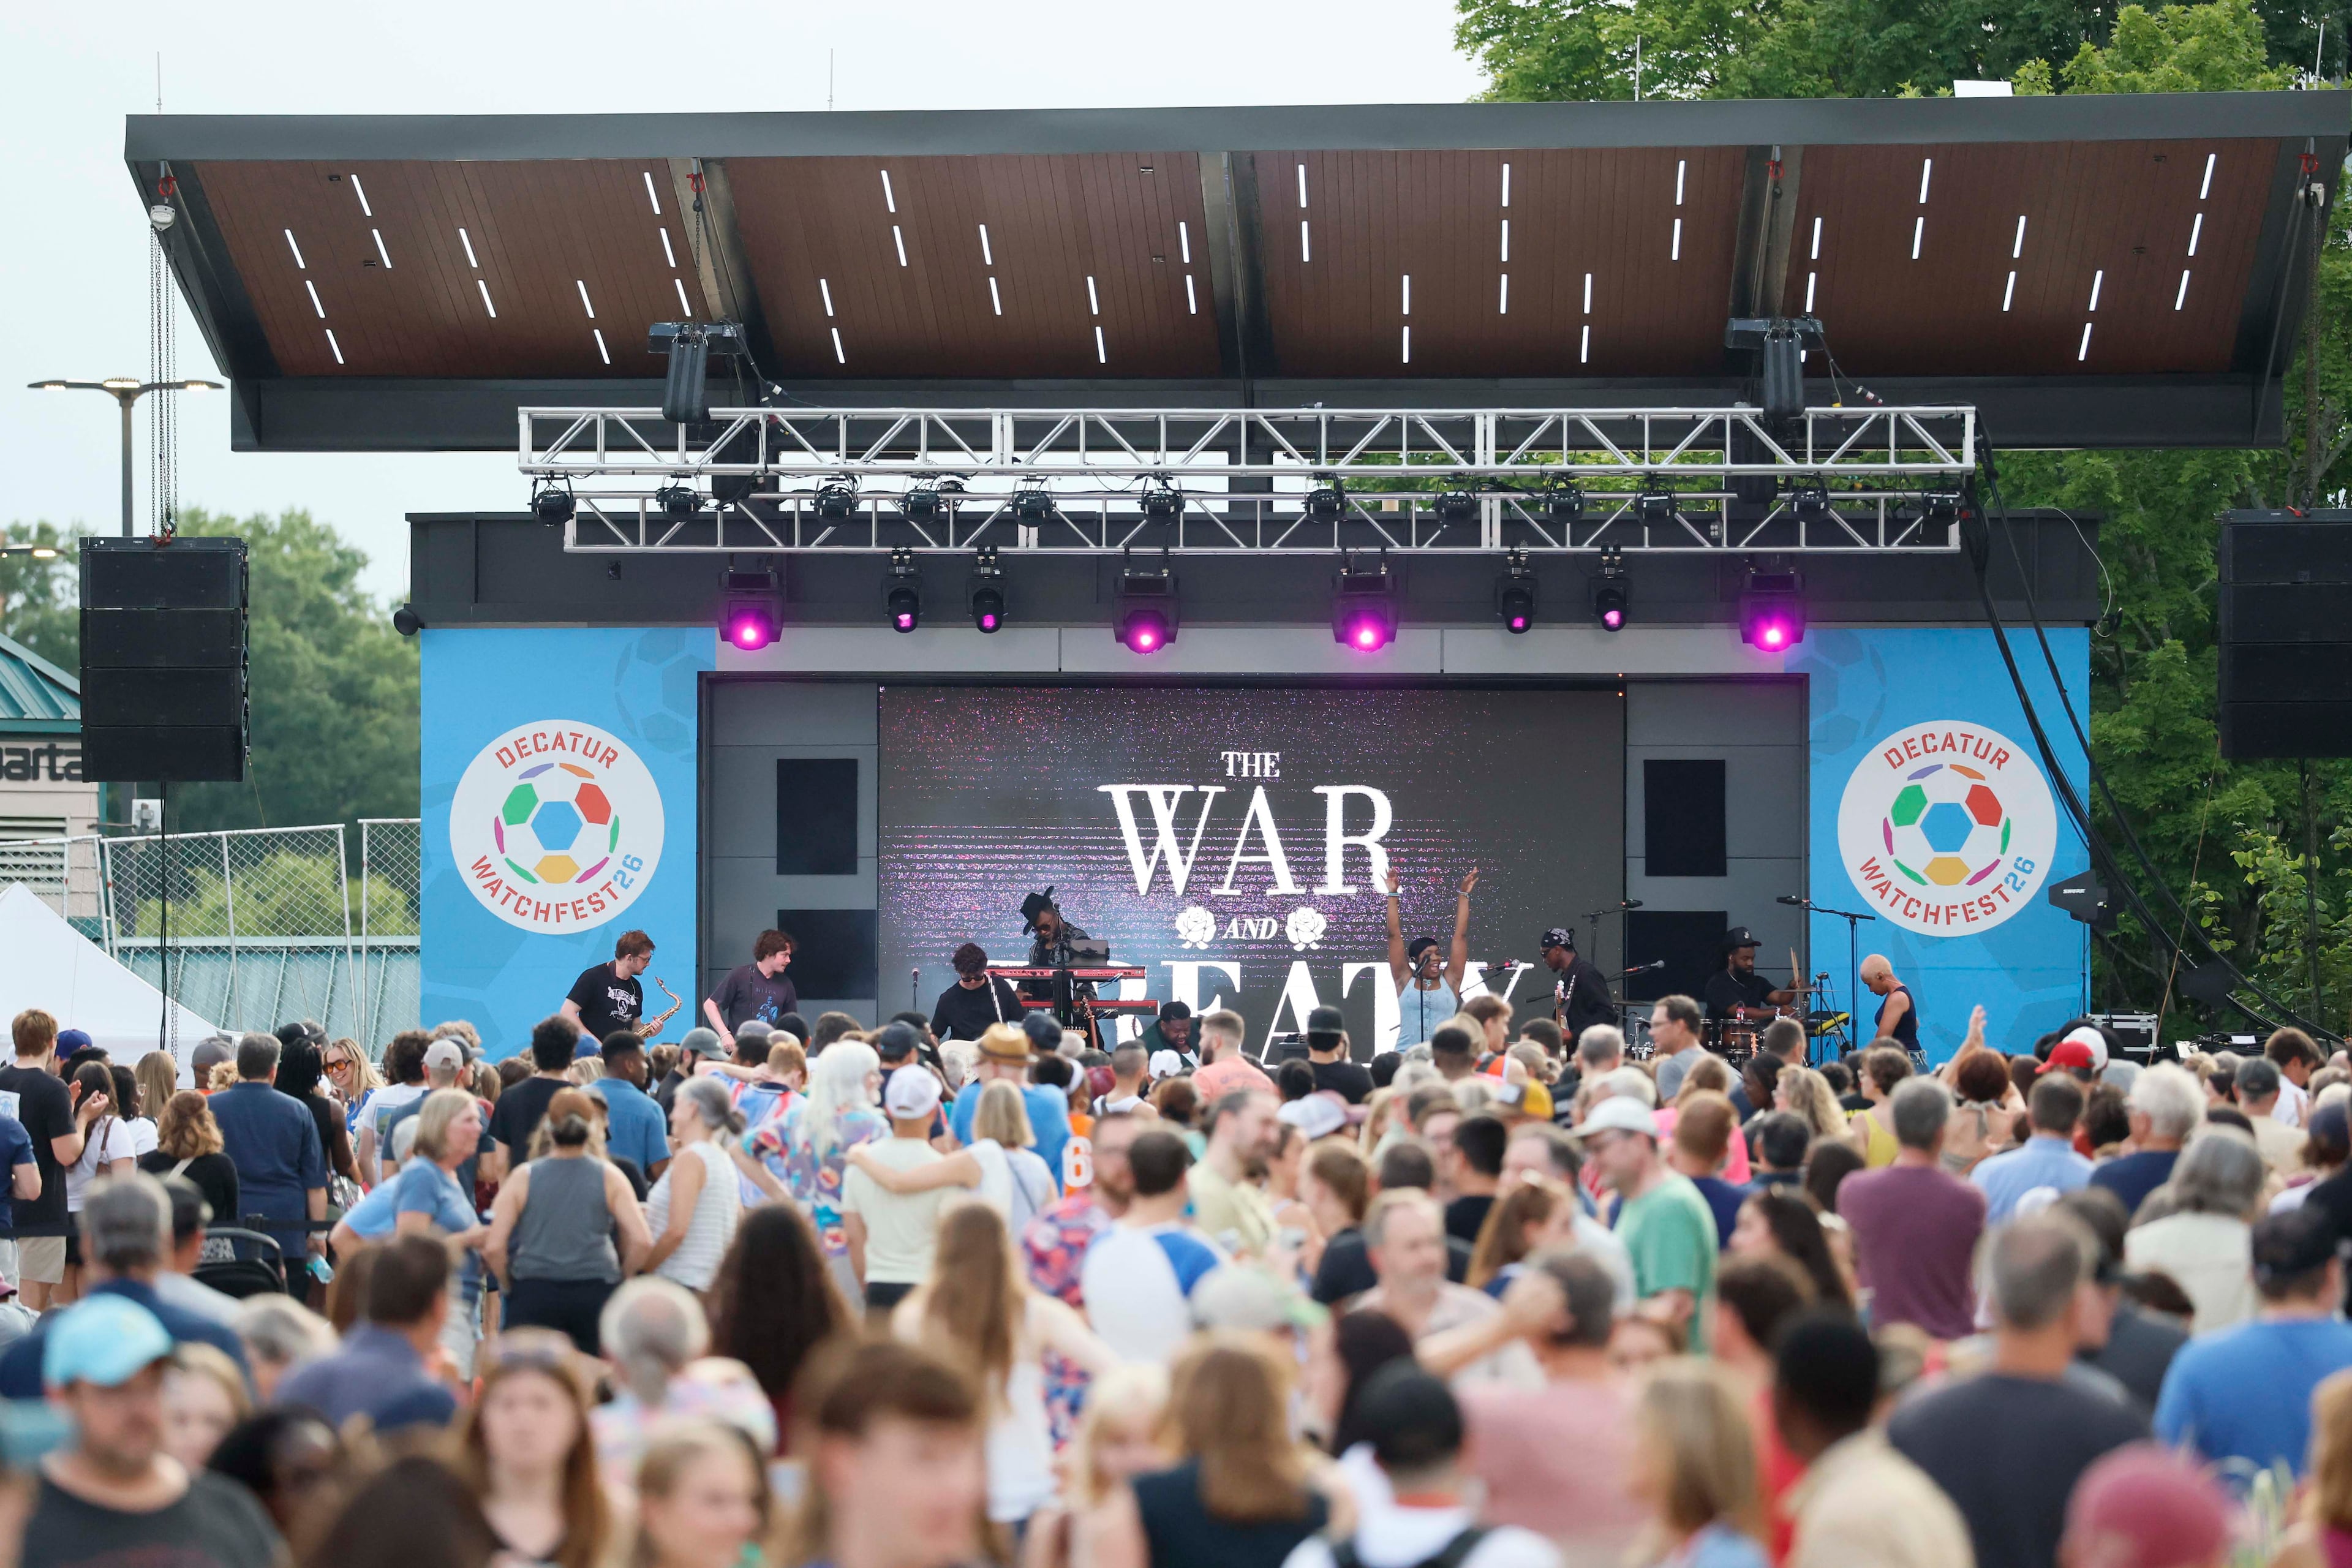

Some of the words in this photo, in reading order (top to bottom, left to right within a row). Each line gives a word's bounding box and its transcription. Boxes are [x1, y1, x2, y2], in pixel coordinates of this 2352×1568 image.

[0, 743, 82, 781] arta
[496, 731, 619, 769] DECATUR
[1221, 751, 1281, 778] THE
[1884, 732, 2010, 770] DECATUR
[1097, 785, 1401, 896] WAR
[1223, 917, 1280, 940] AND
[987, 959, 1535, 1067] EATY
